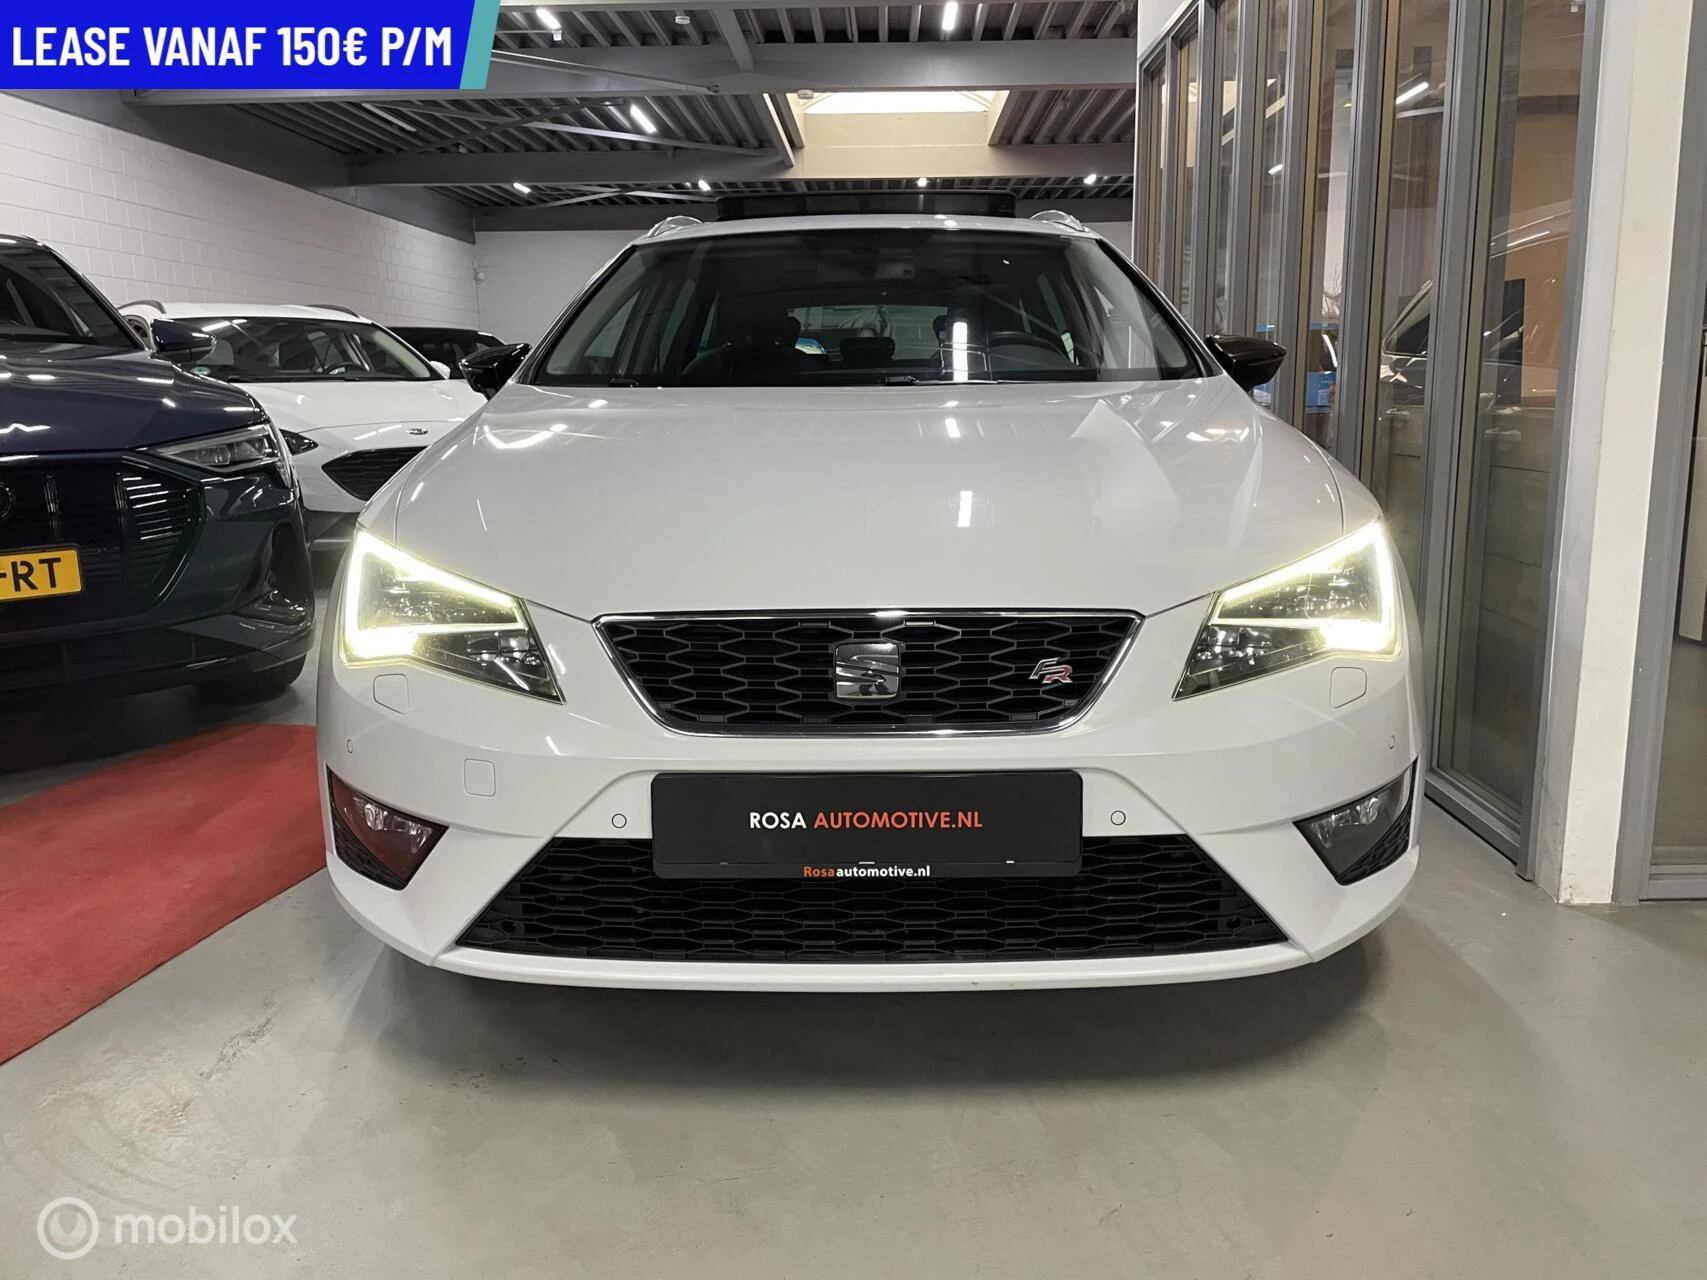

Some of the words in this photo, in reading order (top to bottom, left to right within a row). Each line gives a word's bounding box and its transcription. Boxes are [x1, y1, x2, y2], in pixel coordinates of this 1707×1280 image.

[1028, 657, 1074, 683] FR
[749, 811, 807, 829] ROSA
[813, 811, 983, 829] AUTOMOTIVE.NL
